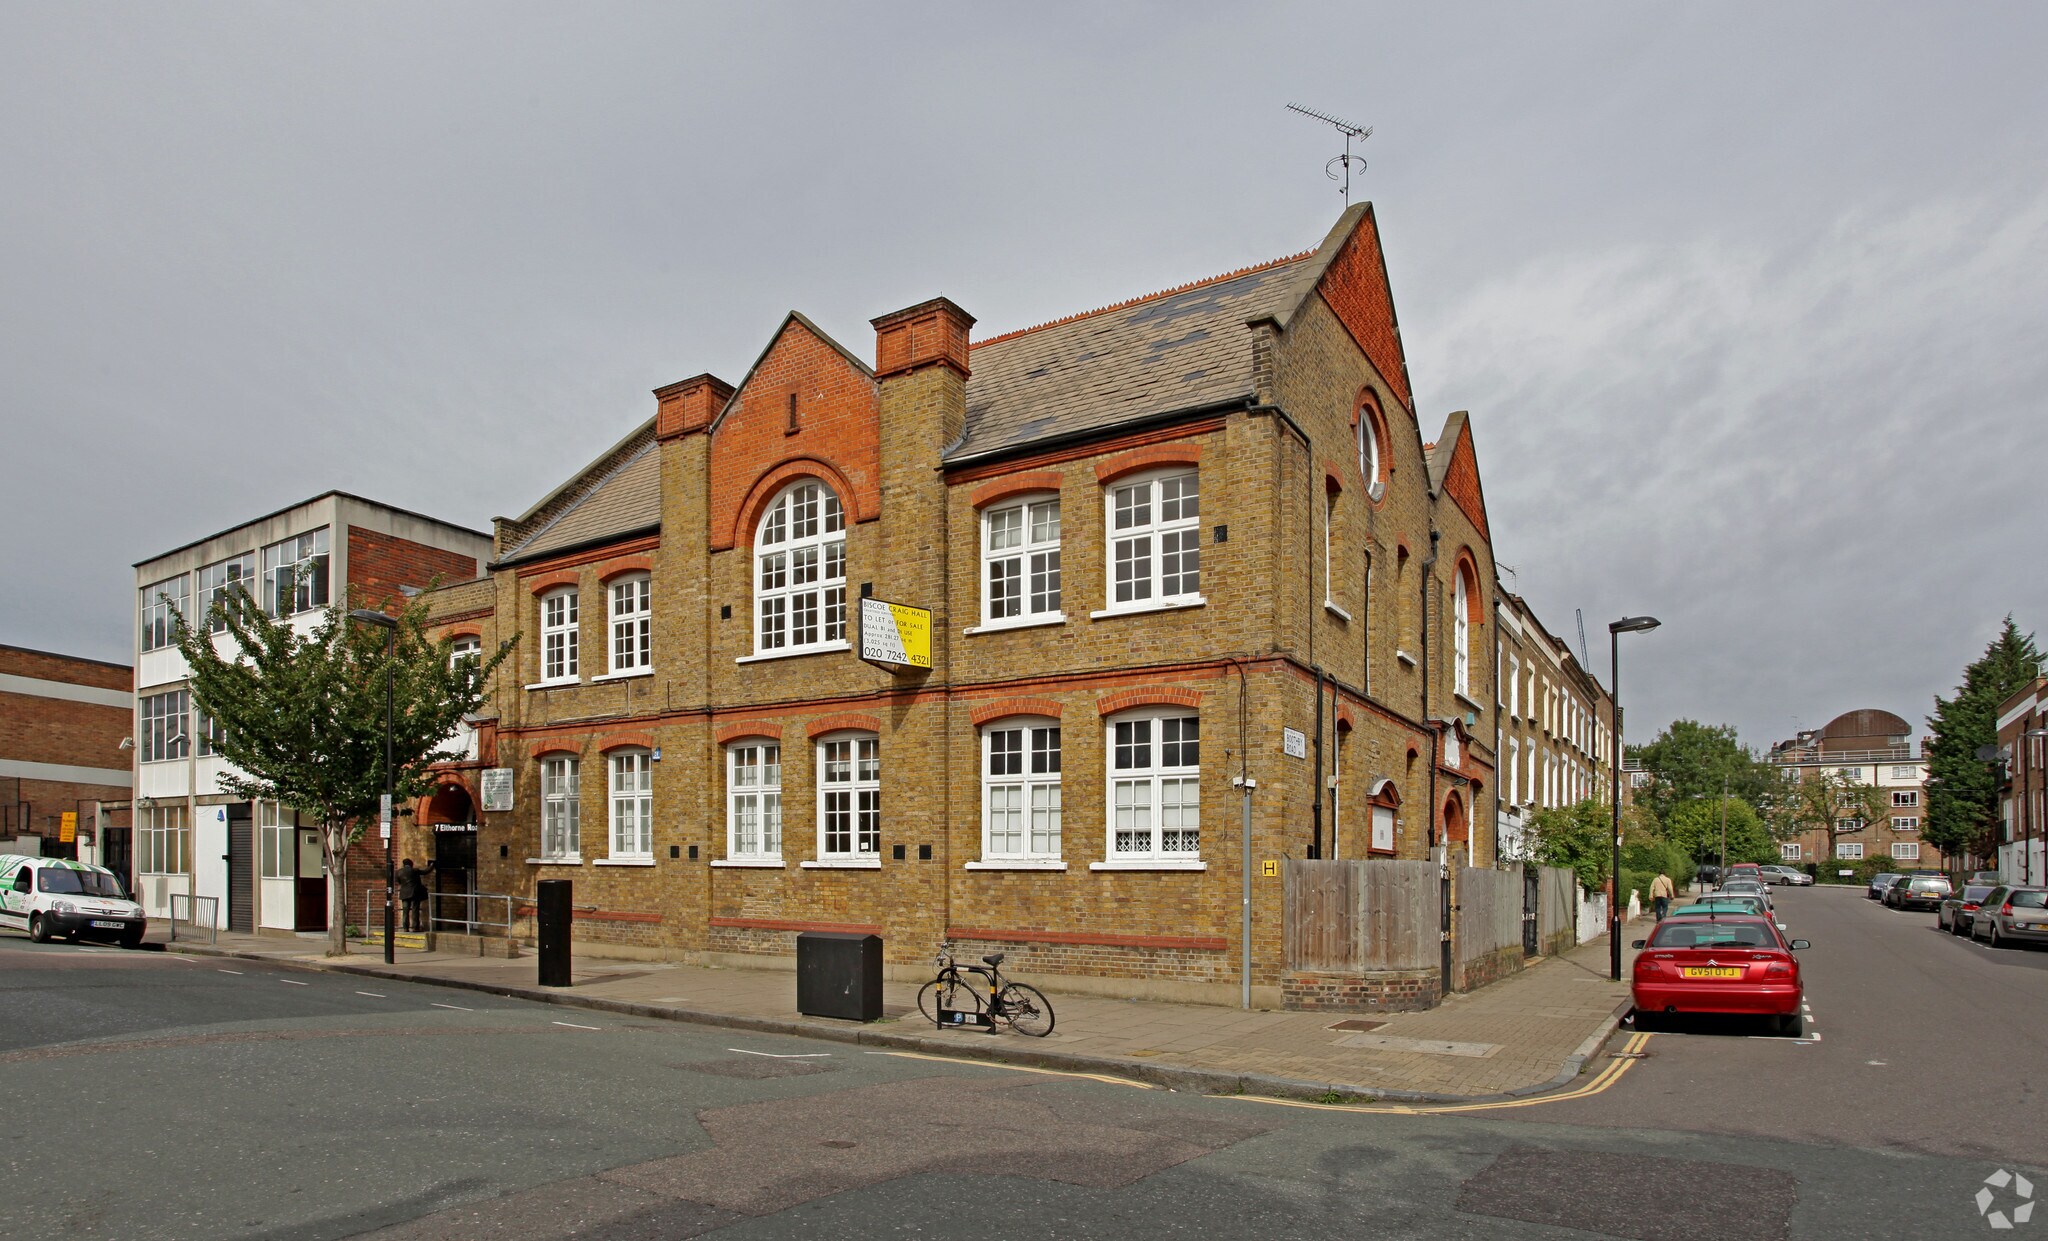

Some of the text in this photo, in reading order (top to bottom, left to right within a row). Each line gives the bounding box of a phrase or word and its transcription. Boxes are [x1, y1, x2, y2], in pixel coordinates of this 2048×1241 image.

[864, 601, 886, 611] BISCOE
[888, 606, 908, 615] CRAIG
[911, 609, 927, 618] HALL
[875, 615, 885, 623] LET
[864, 646, 929, 666] 020 7242 4321
[435, 824, 440, 832] 7
[440, 824, 466, 832] Elthorne
[1264, 862, 1275, 875] H
